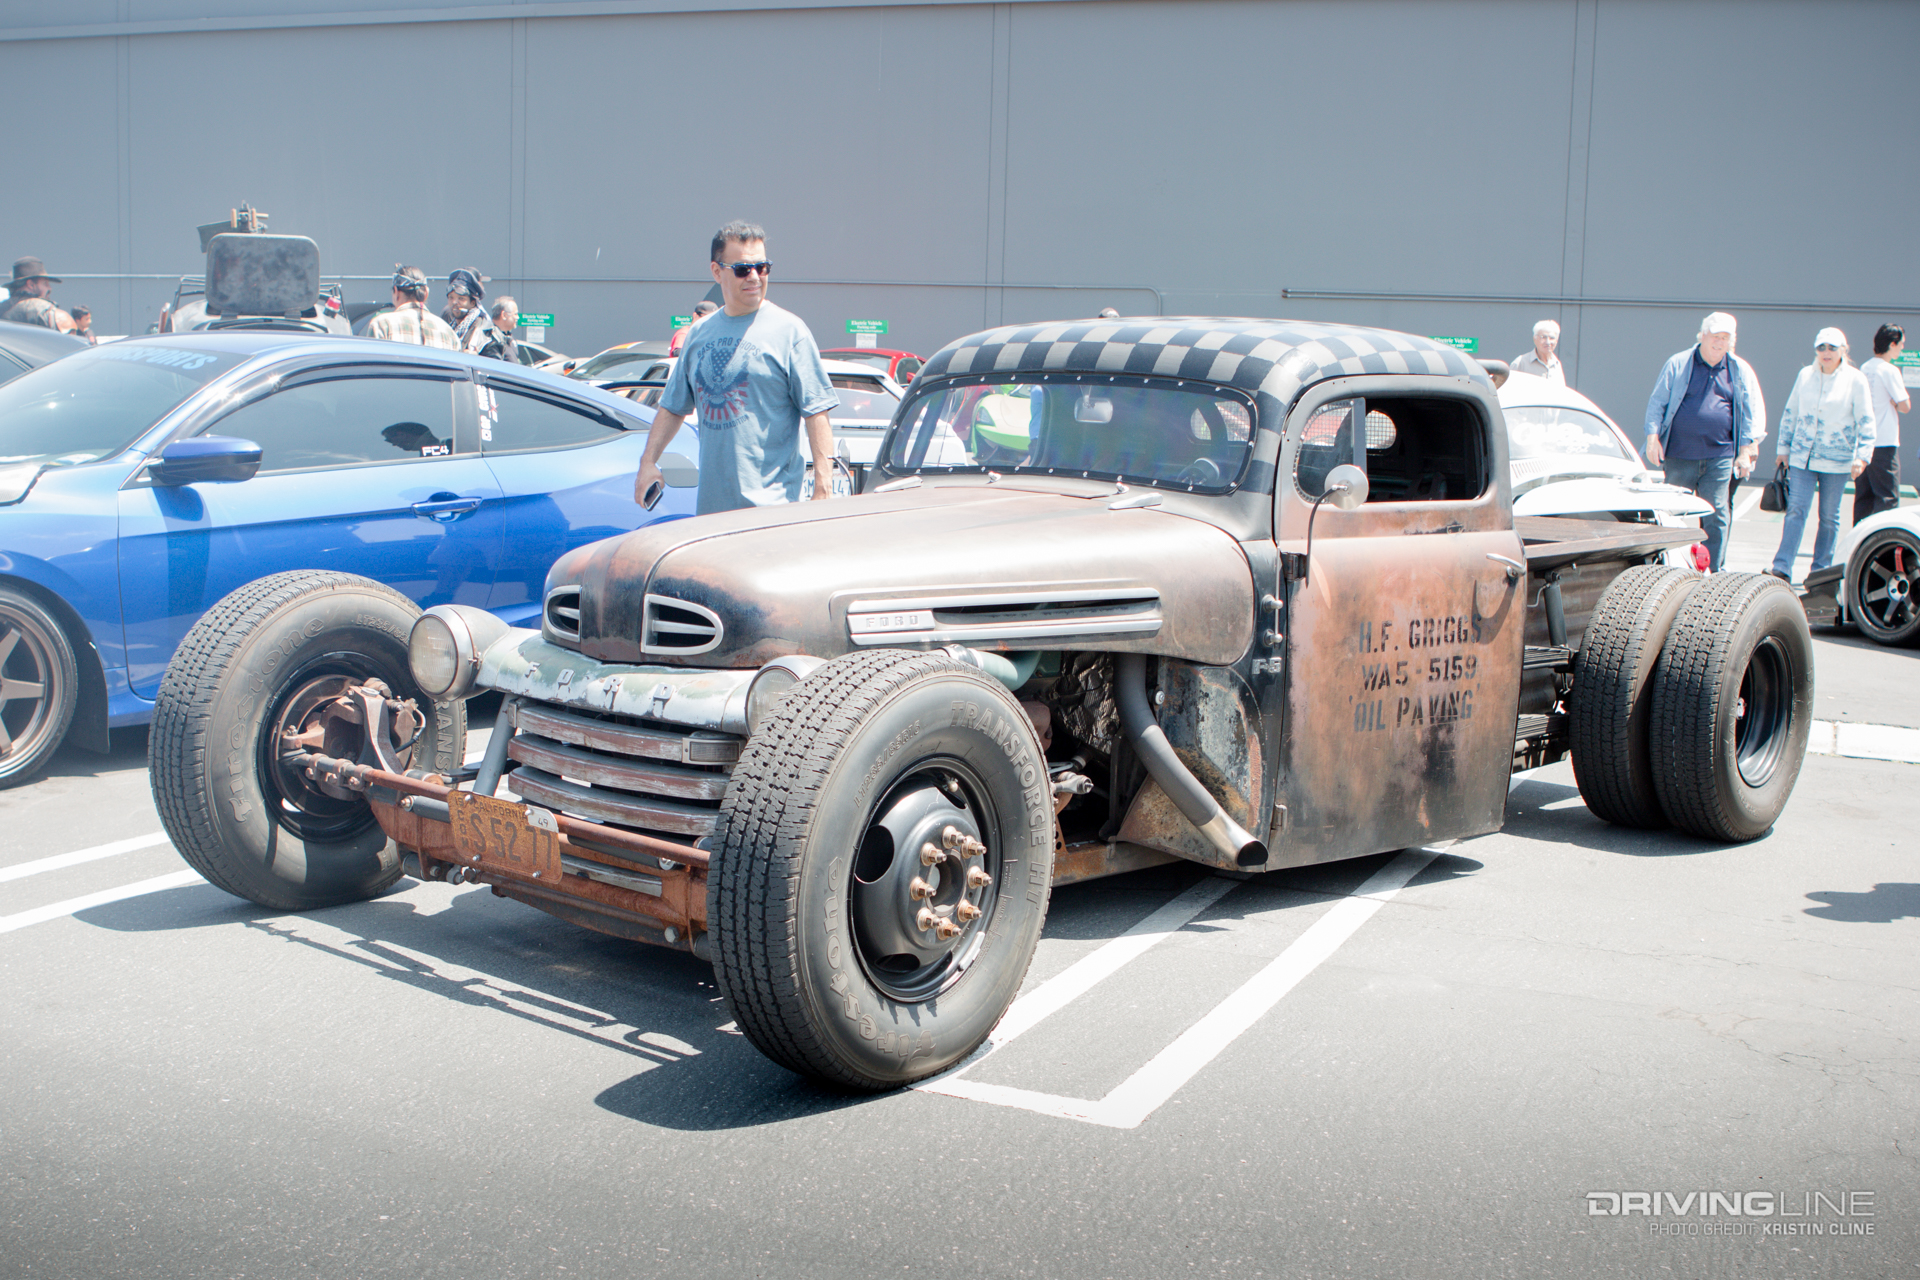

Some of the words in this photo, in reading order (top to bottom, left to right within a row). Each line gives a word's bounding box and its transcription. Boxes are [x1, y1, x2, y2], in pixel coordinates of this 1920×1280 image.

[717, 337, 734, 347] PRO
[735, 338, 761, 357] SHOPS
[421, 445, 450, 456] FC4
[865, 615, 919, 629] FORD
[1408, 614, 1482, 650] GRIGGS
[525, 661, 675, 700] FORD
[948, 700, 1047, 846] TRANSFORCE
[825, 855, 937, 1061] Firestone
